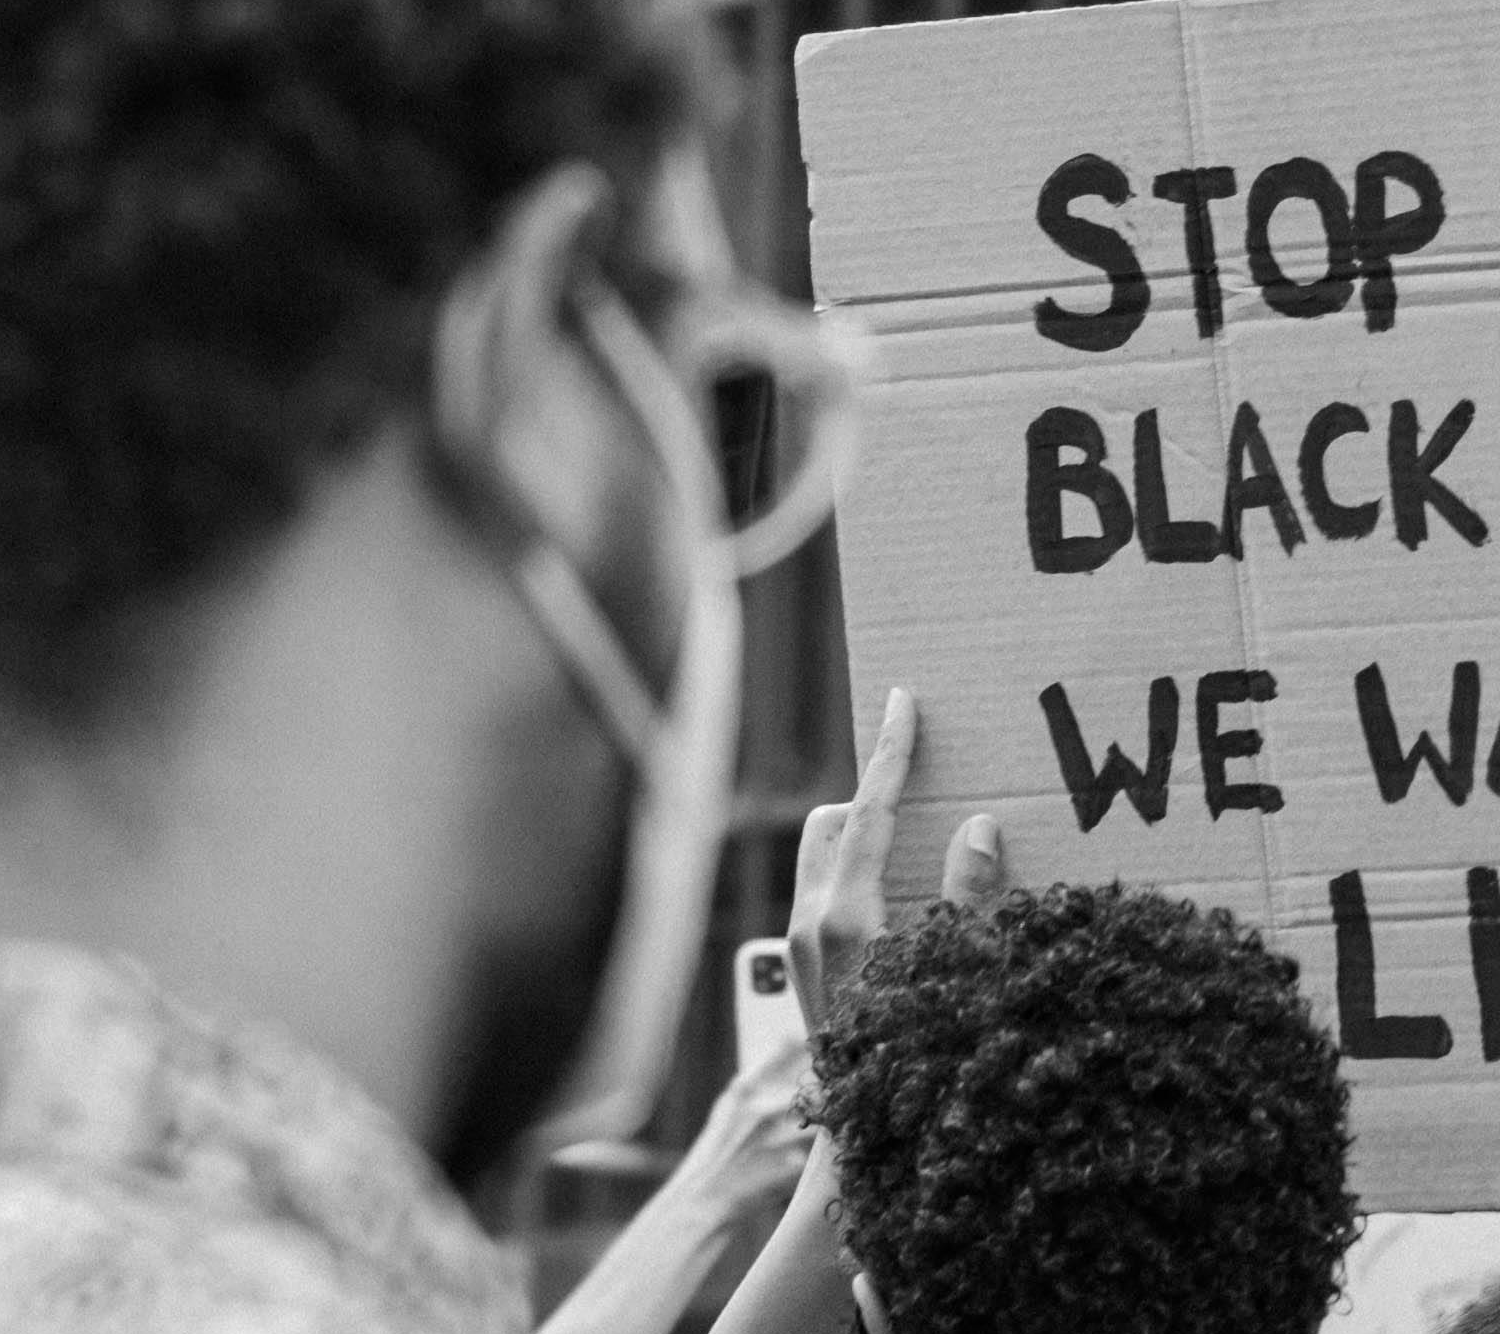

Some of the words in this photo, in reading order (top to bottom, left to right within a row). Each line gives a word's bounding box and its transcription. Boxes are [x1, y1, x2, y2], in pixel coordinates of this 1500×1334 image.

[1033, 149, 1447, 354] STOP
[1024, 397, 1491, 576] BLACK
[1038, 667, 1286, 834] WE
